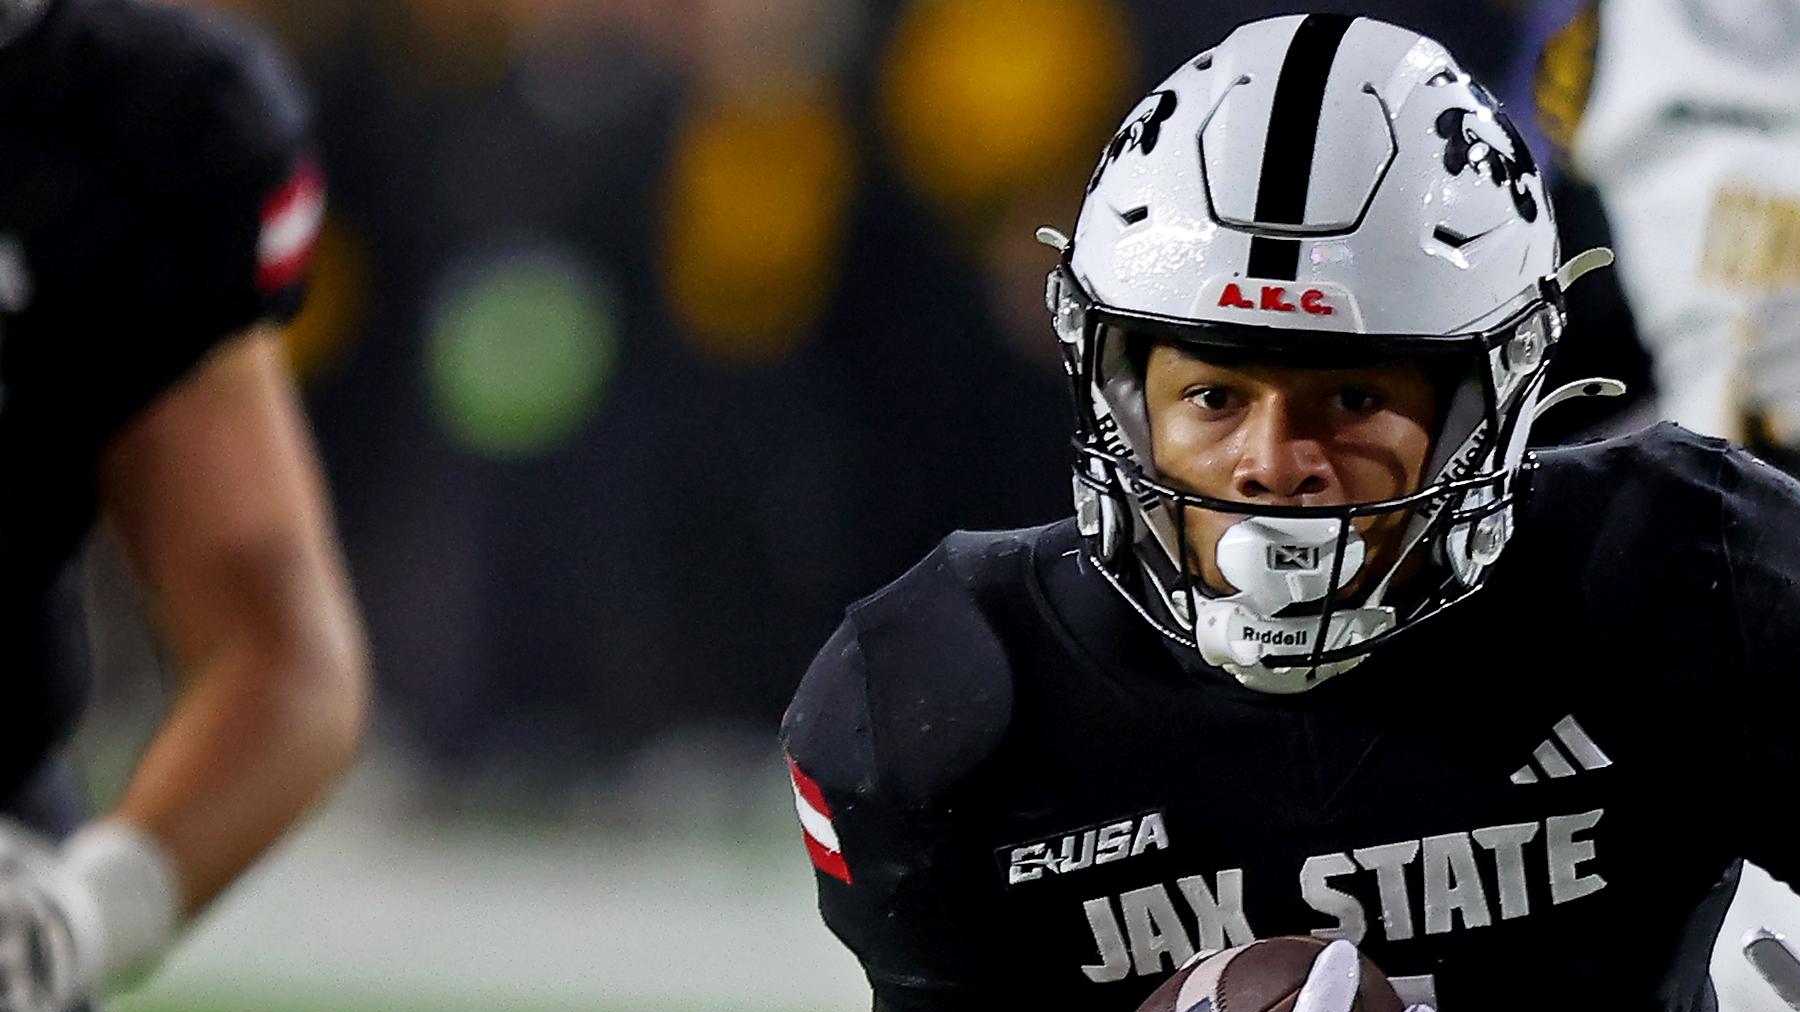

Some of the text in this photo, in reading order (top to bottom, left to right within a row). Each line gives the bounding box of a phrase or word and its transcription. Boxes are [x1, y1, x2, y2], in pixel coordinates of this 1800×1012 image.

[1242, 625, 1307, 646] Riddell
[1080, 808, 1608, 984] JAX STATE
